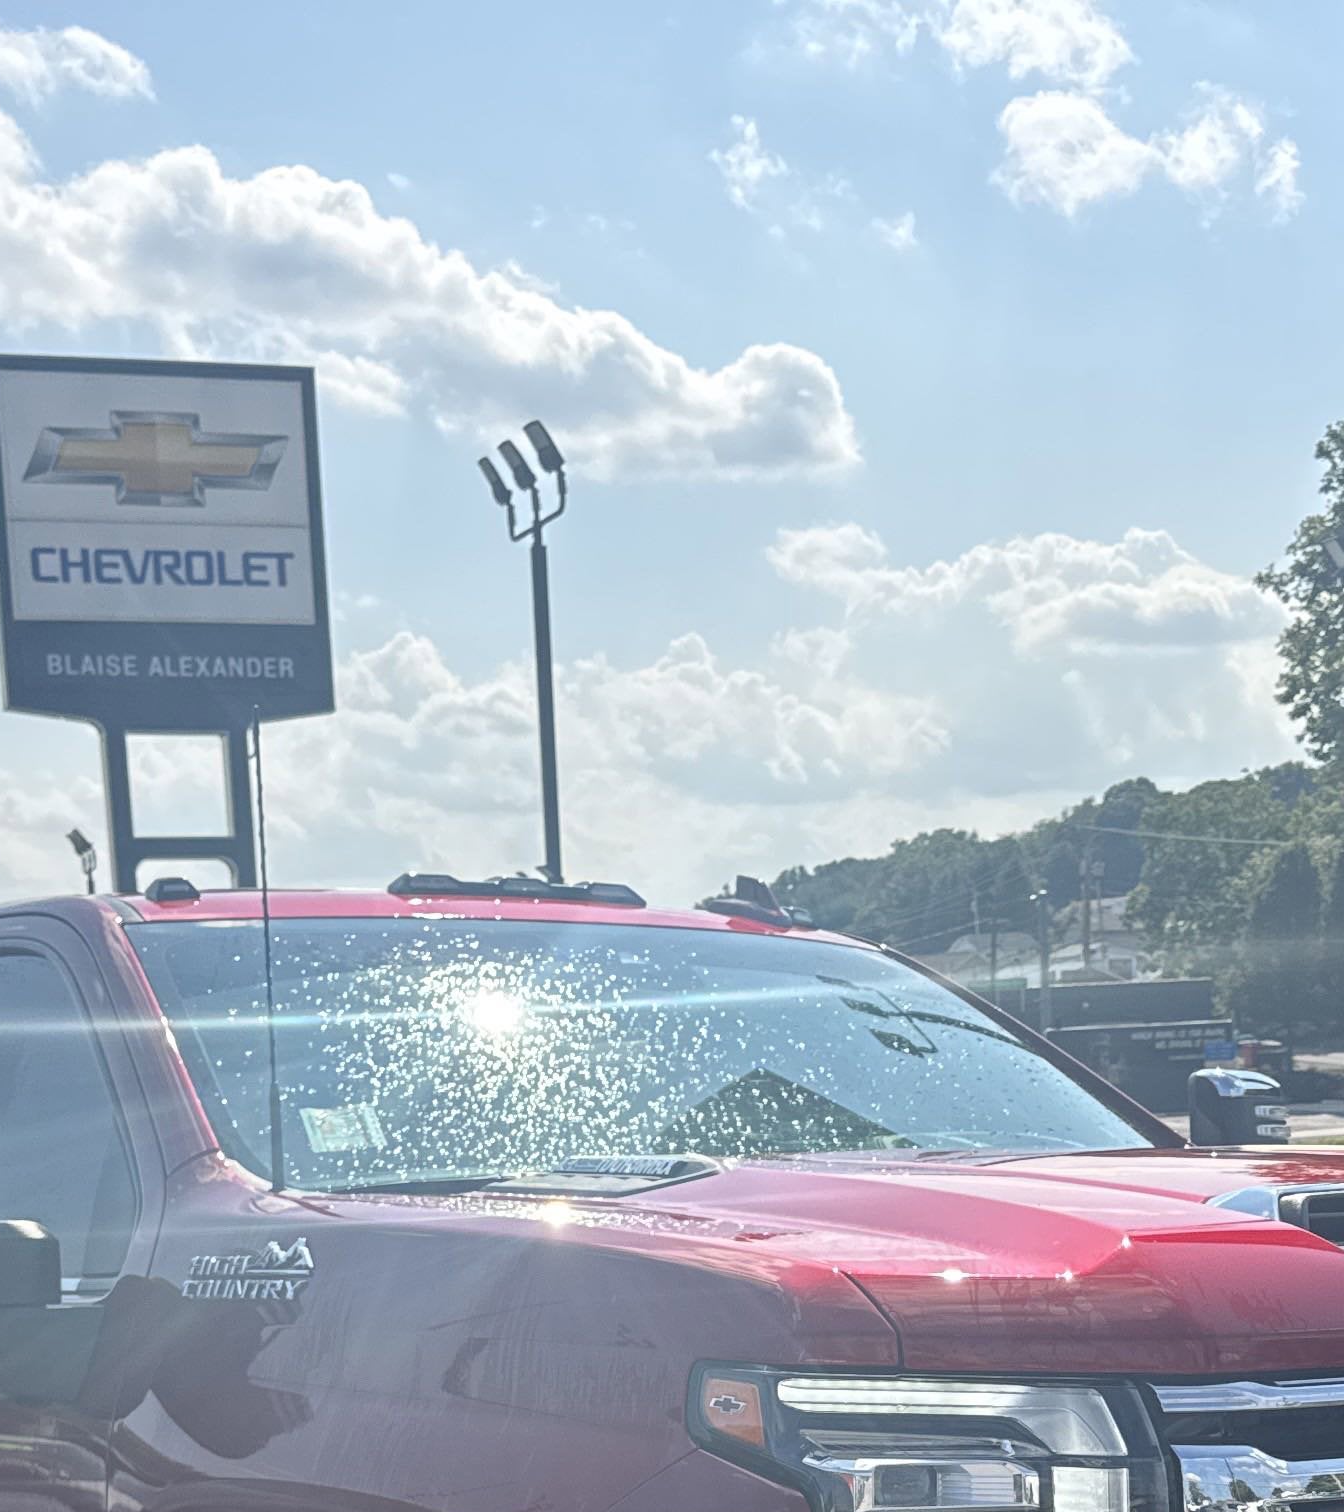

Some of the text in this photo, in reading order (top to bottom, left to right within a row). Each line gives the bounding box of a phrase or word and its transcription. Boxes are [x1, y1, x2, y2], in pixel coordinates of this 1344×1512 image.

[30, 546, 295, 588] CHEVROLET
[46, 653, 295, 679] BLAISE ALEXANDER
[189, 1254, 252, 1276] HIGH
[181, 1279, 308, 1300] COUNTRY
